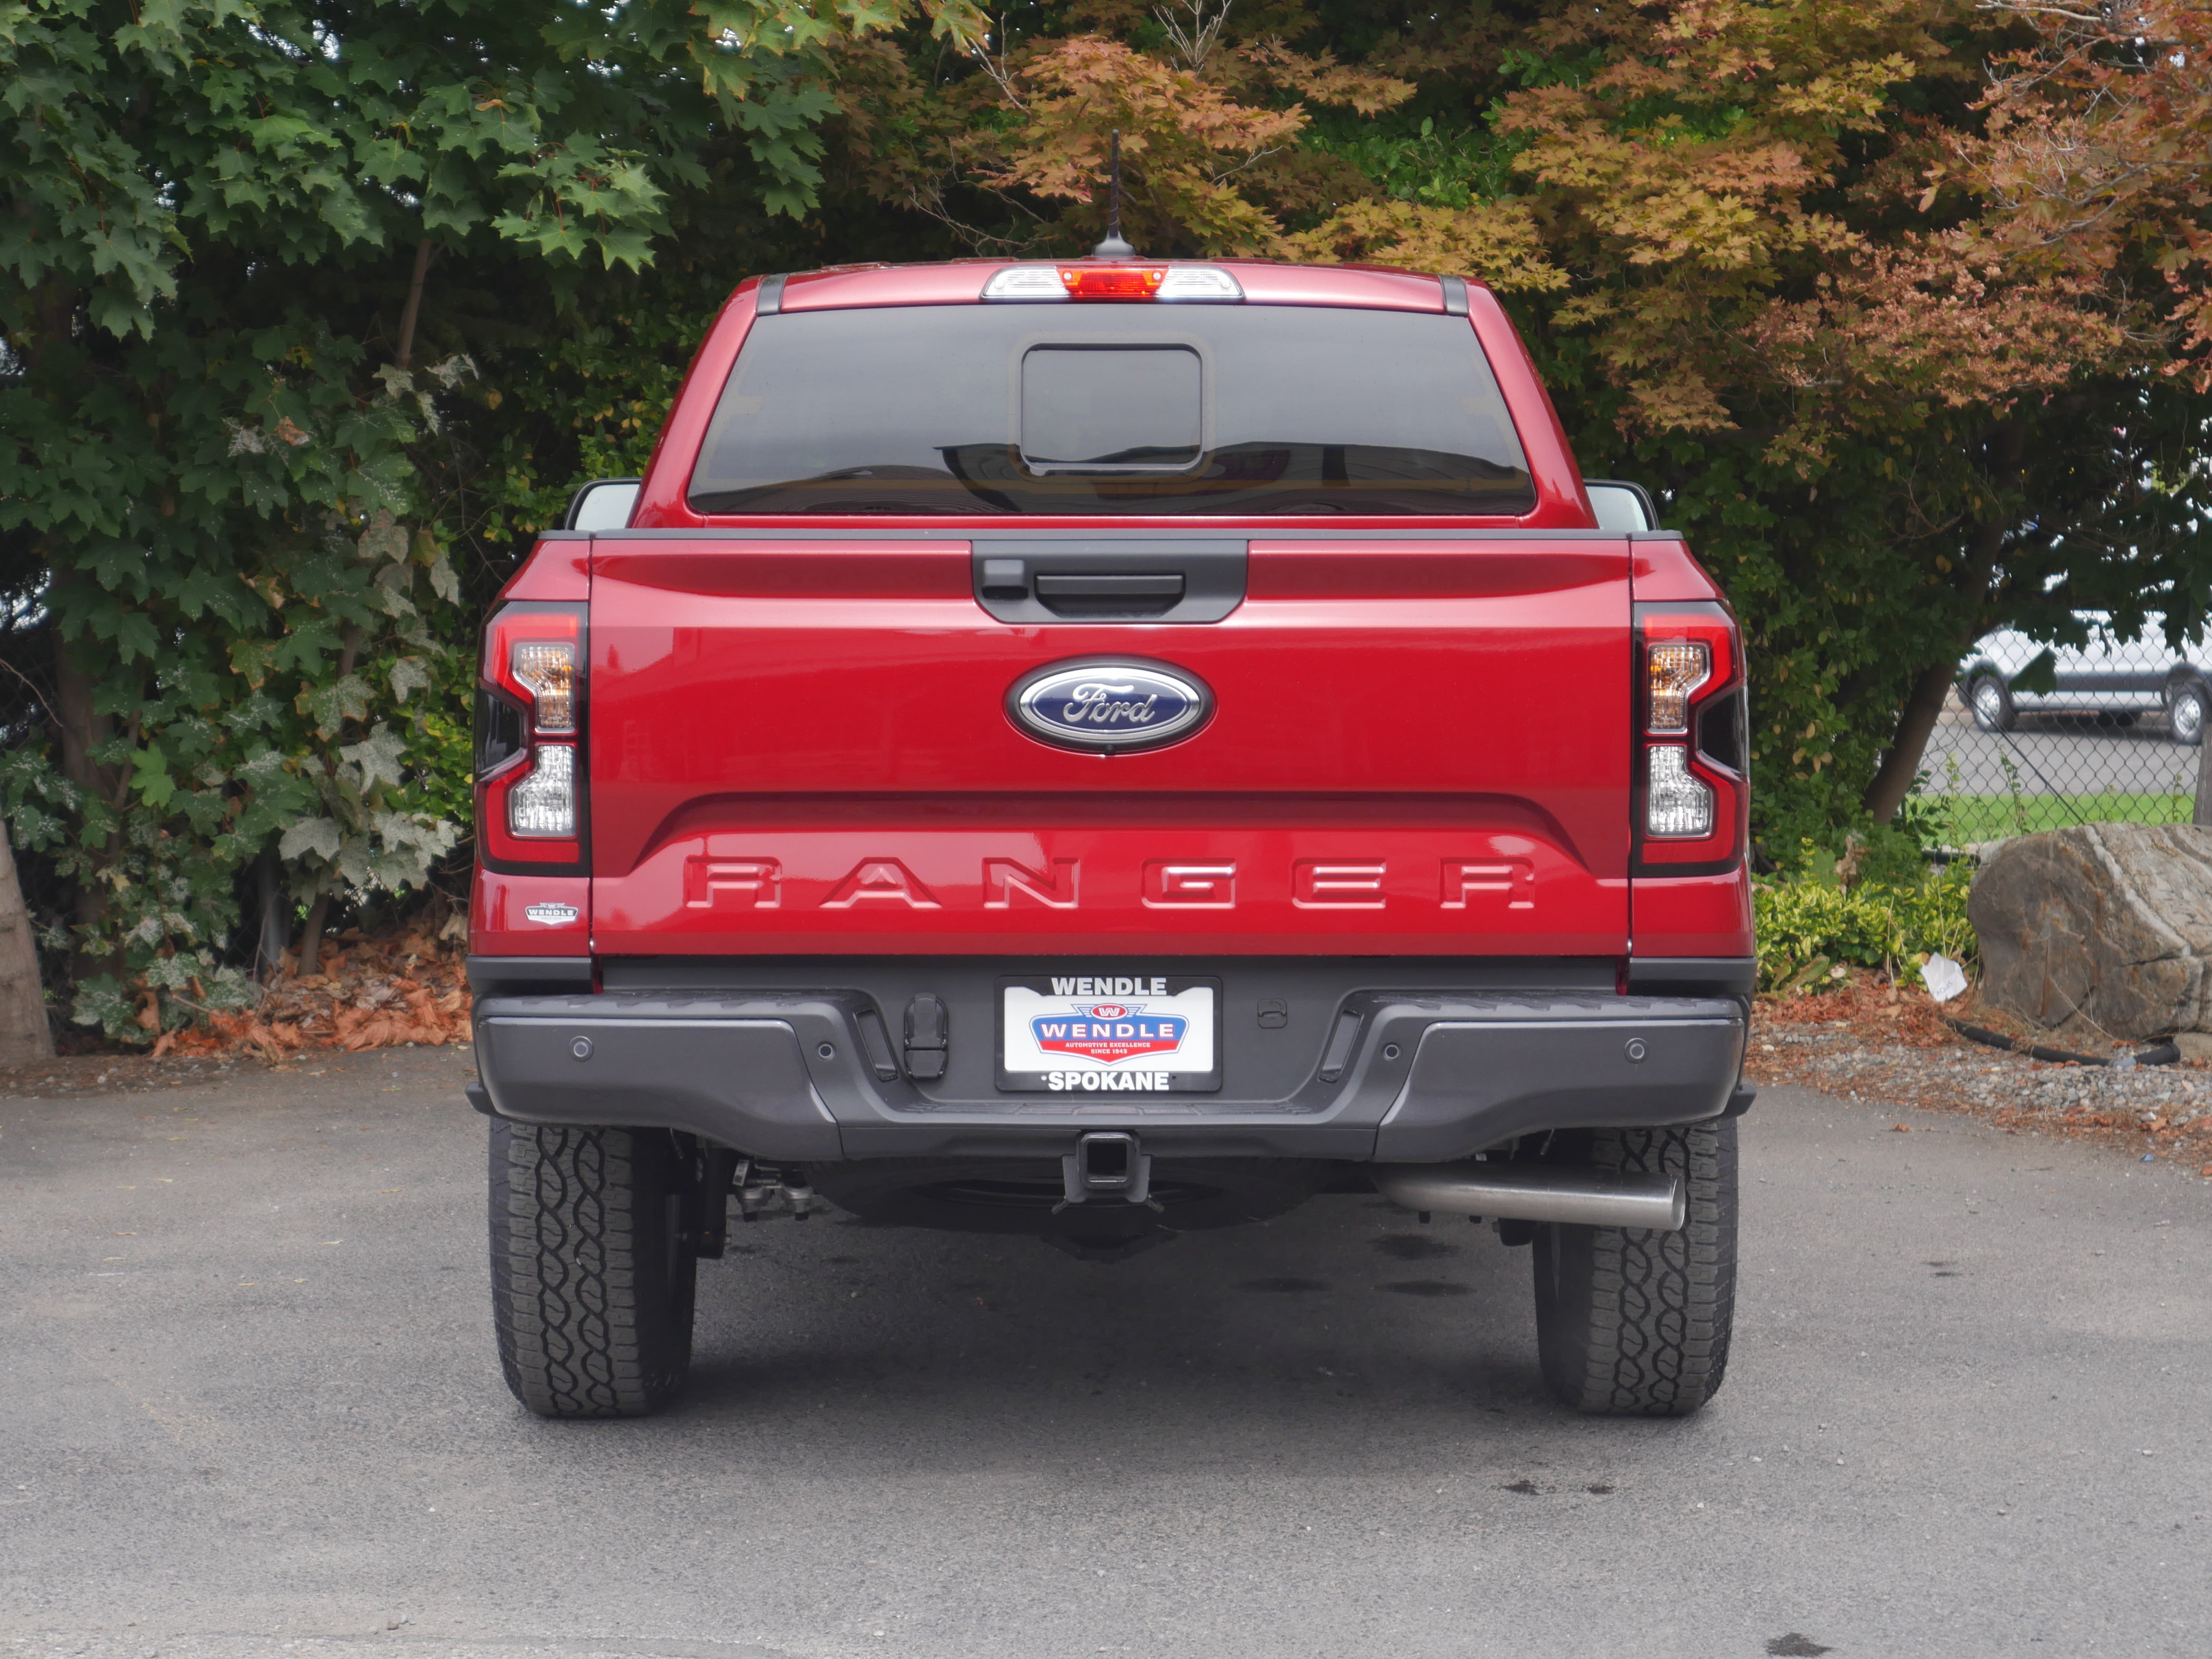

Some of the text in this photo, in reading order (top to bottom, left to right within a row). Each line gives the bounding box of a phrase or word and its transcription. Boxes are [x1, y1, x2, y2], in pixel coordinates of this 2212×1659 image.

[1064, 683, 1157, 722] Ford
[684, 857, 1534, 908] RANGER
[1051, 977, 1167, 995] WENDLE
[1098, 1007, 1120, 1016] W
[1041, 1024, 1174, 1037] WENDLE
[1048, 1072, 1170, 1091] SPOKANE
